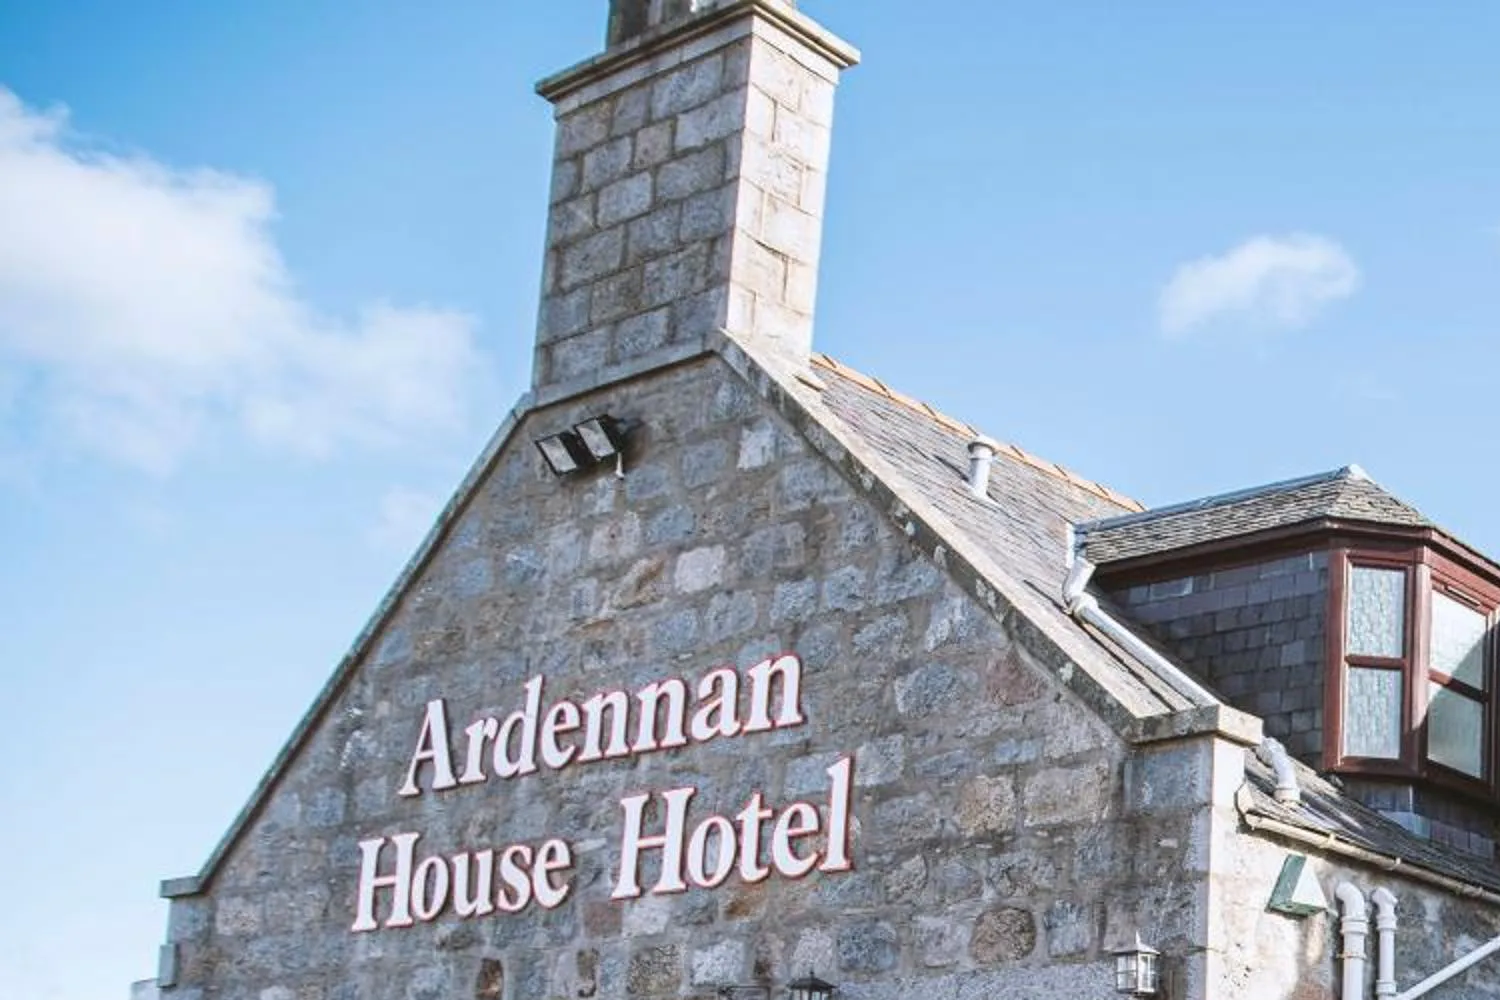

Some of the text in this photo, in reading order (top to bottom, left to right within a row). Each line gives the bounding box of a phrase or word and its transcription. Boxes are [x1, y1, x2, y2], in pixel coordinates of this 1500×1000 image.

[399, 653, 806, 797] Ardennan
[351, 755, 854, 932] House Hotel
